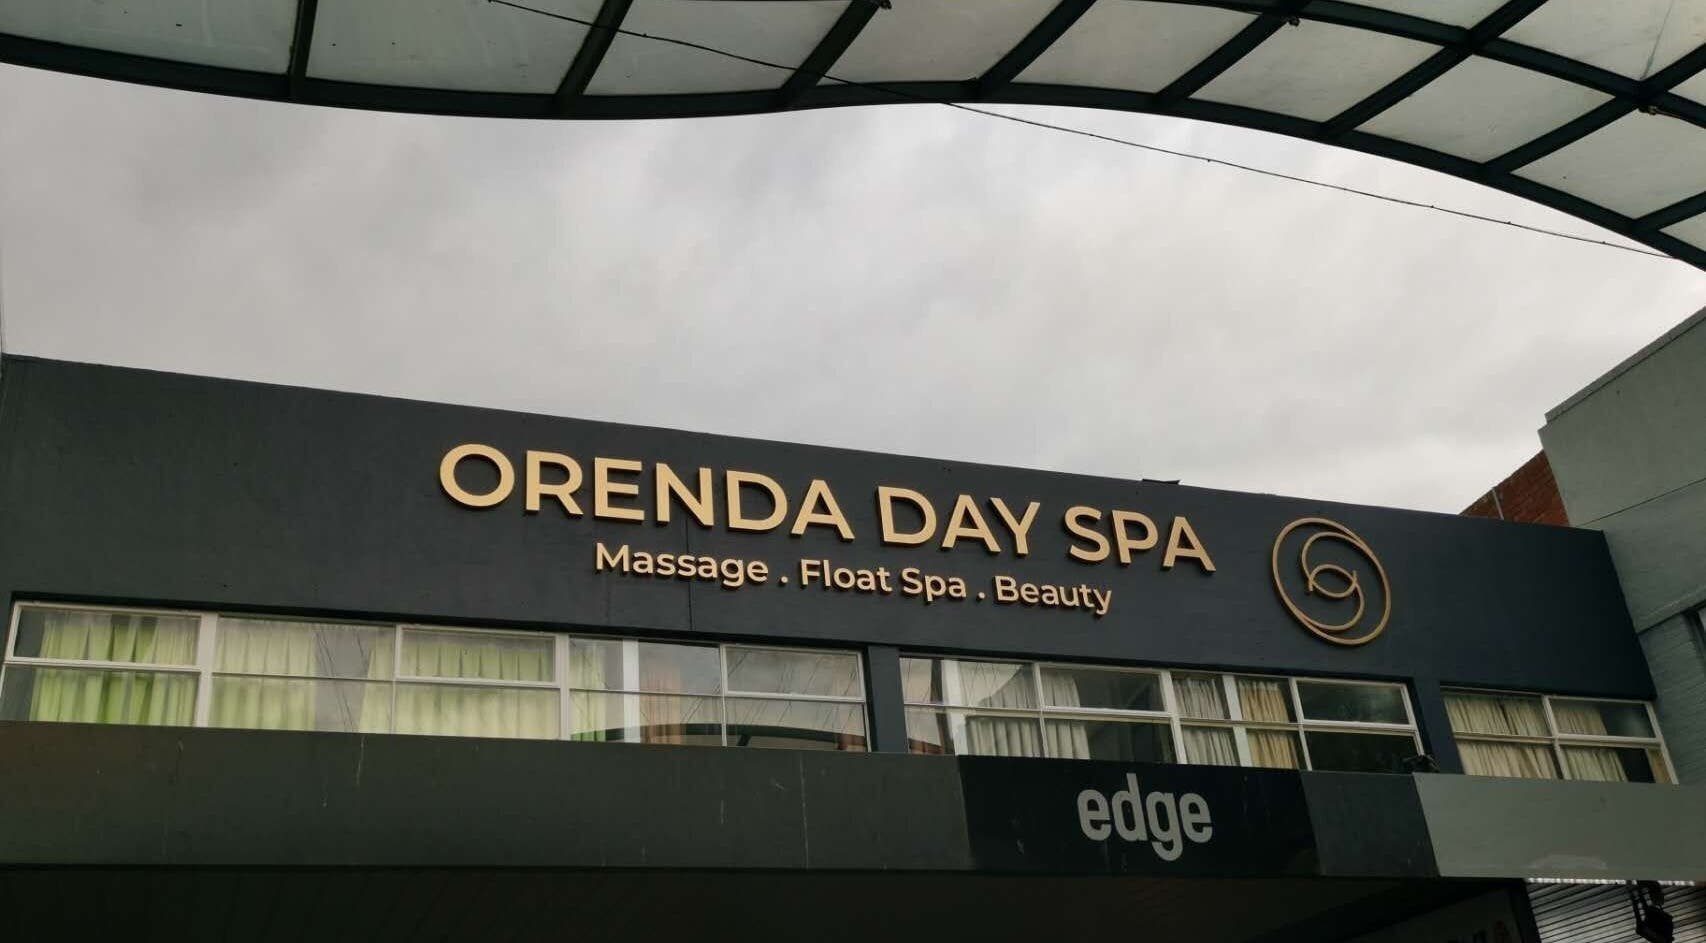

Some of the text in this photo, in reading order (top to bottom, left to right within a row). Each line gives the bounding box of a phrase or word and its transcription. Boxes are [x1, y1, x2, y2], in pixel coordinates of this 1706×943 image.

[438, 442, 1216, 572] ORENDA DAY SPA
[595, 541, 770, 588] Massage
[799, 557, 892, 592] Float
[901, 566, 967, 602] Spa
[995, 574, 1113, 616] Beauty
[1077, 773, 1213, 861] edge
